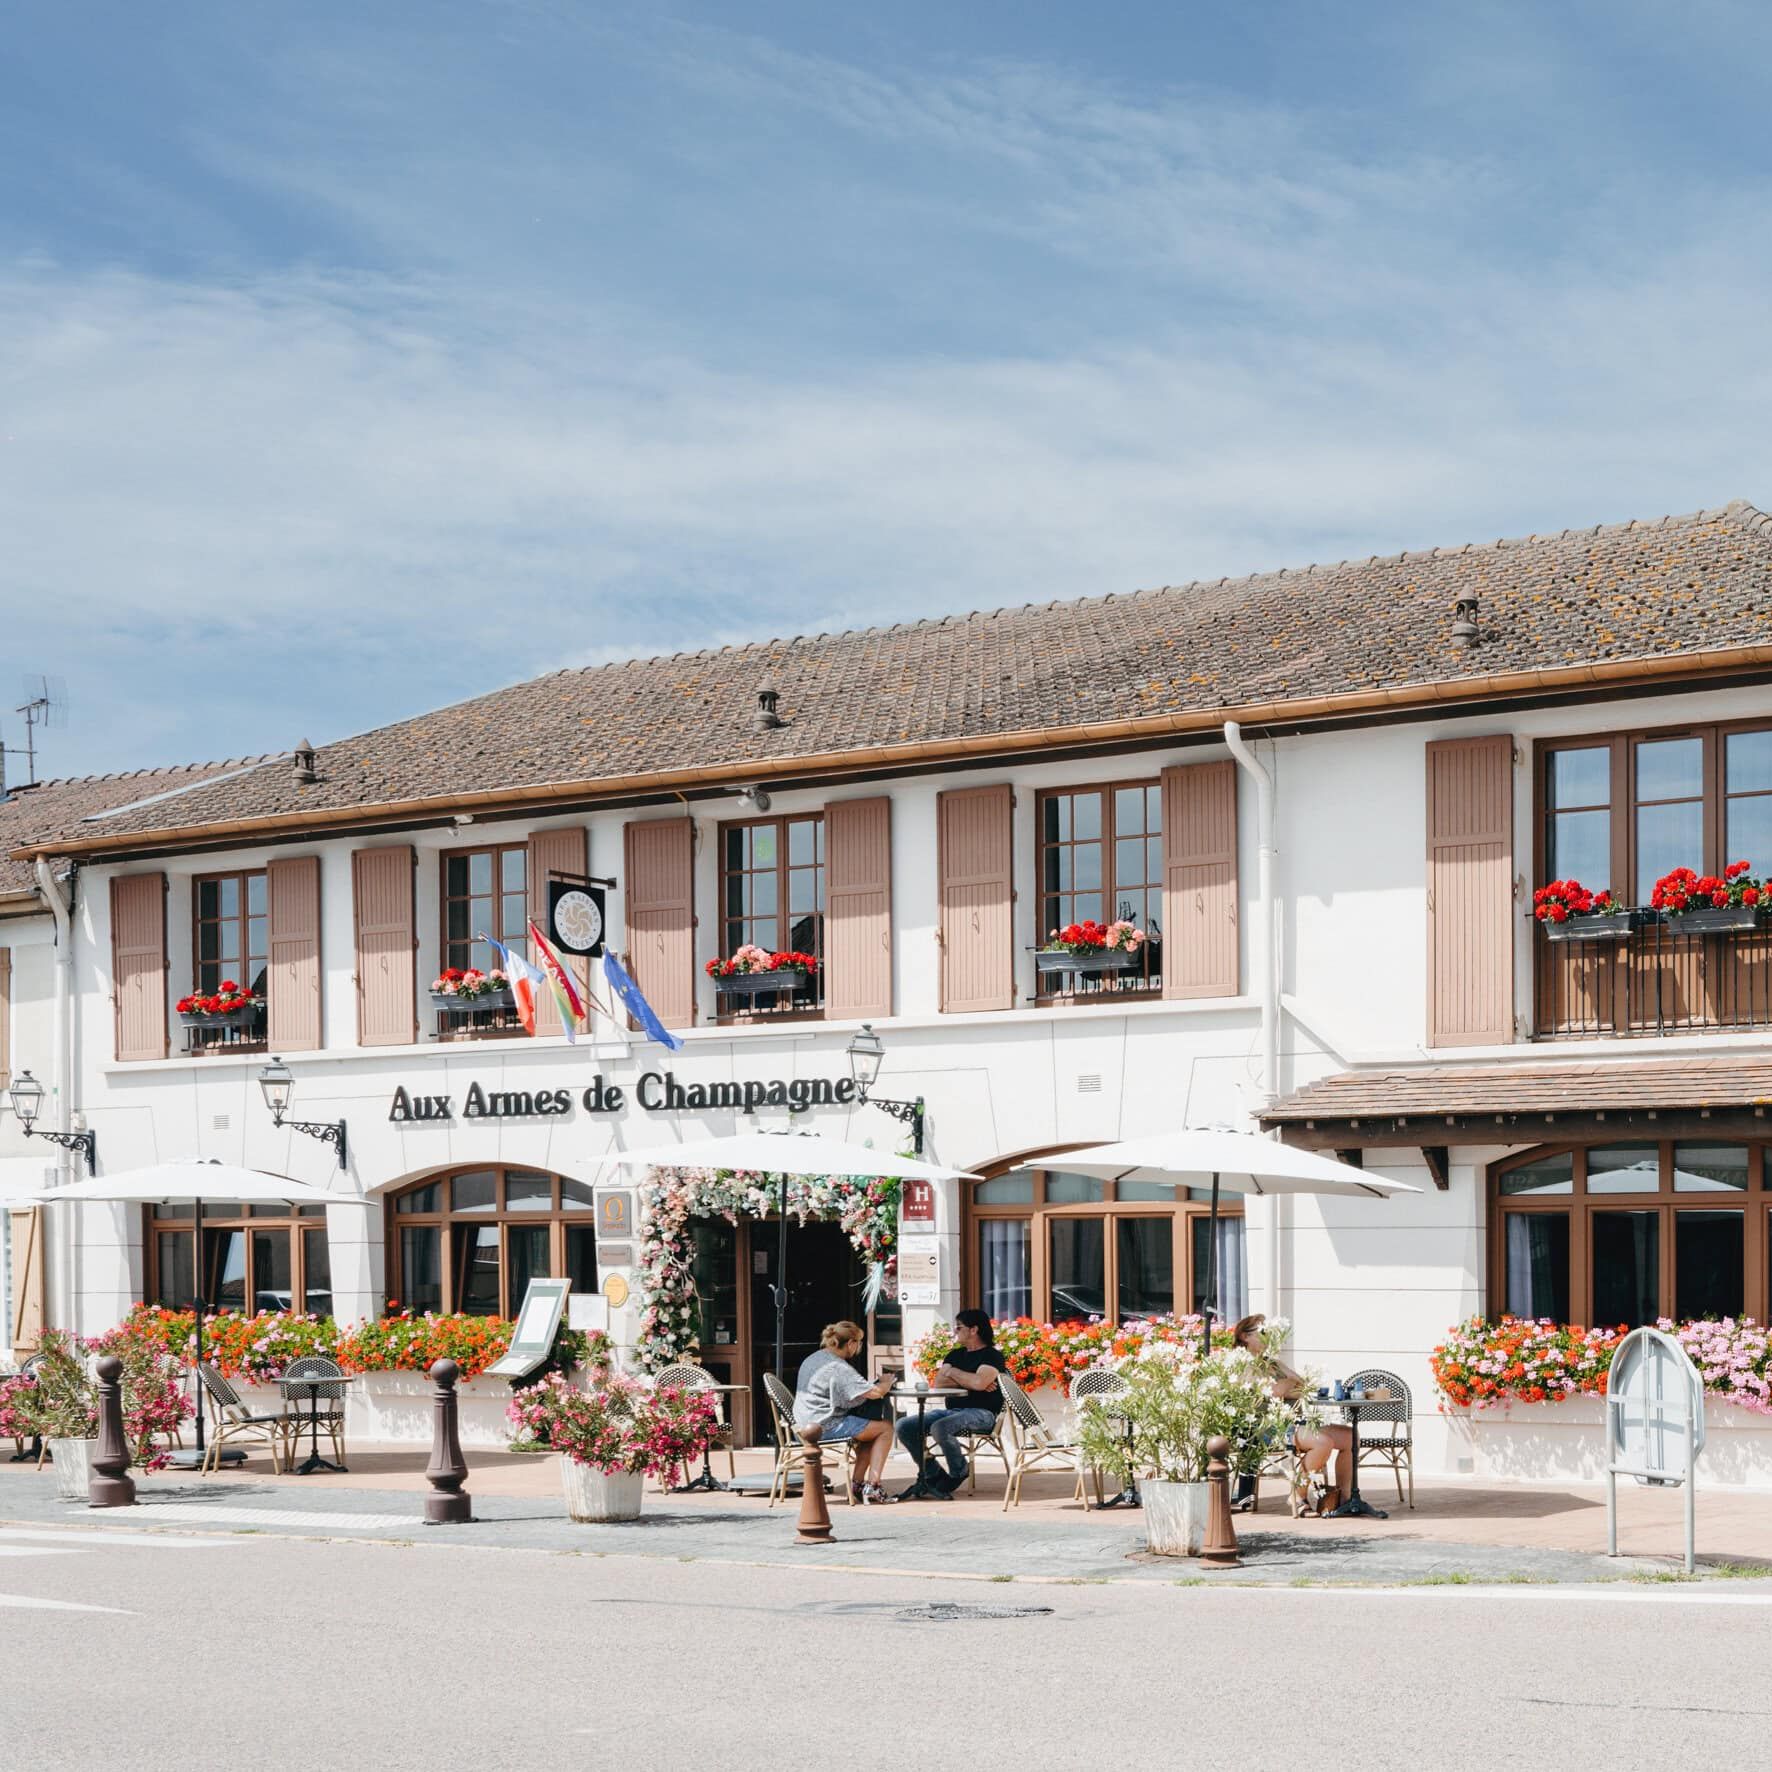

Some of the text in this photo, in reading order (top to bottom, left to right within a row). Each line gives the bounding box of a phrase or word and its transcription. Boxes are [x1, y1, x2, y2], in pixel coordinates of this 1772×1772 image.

[389, 1071, 856, 1122] Aux Armes de Champagne
[915, 1186, 929, 1202] H
